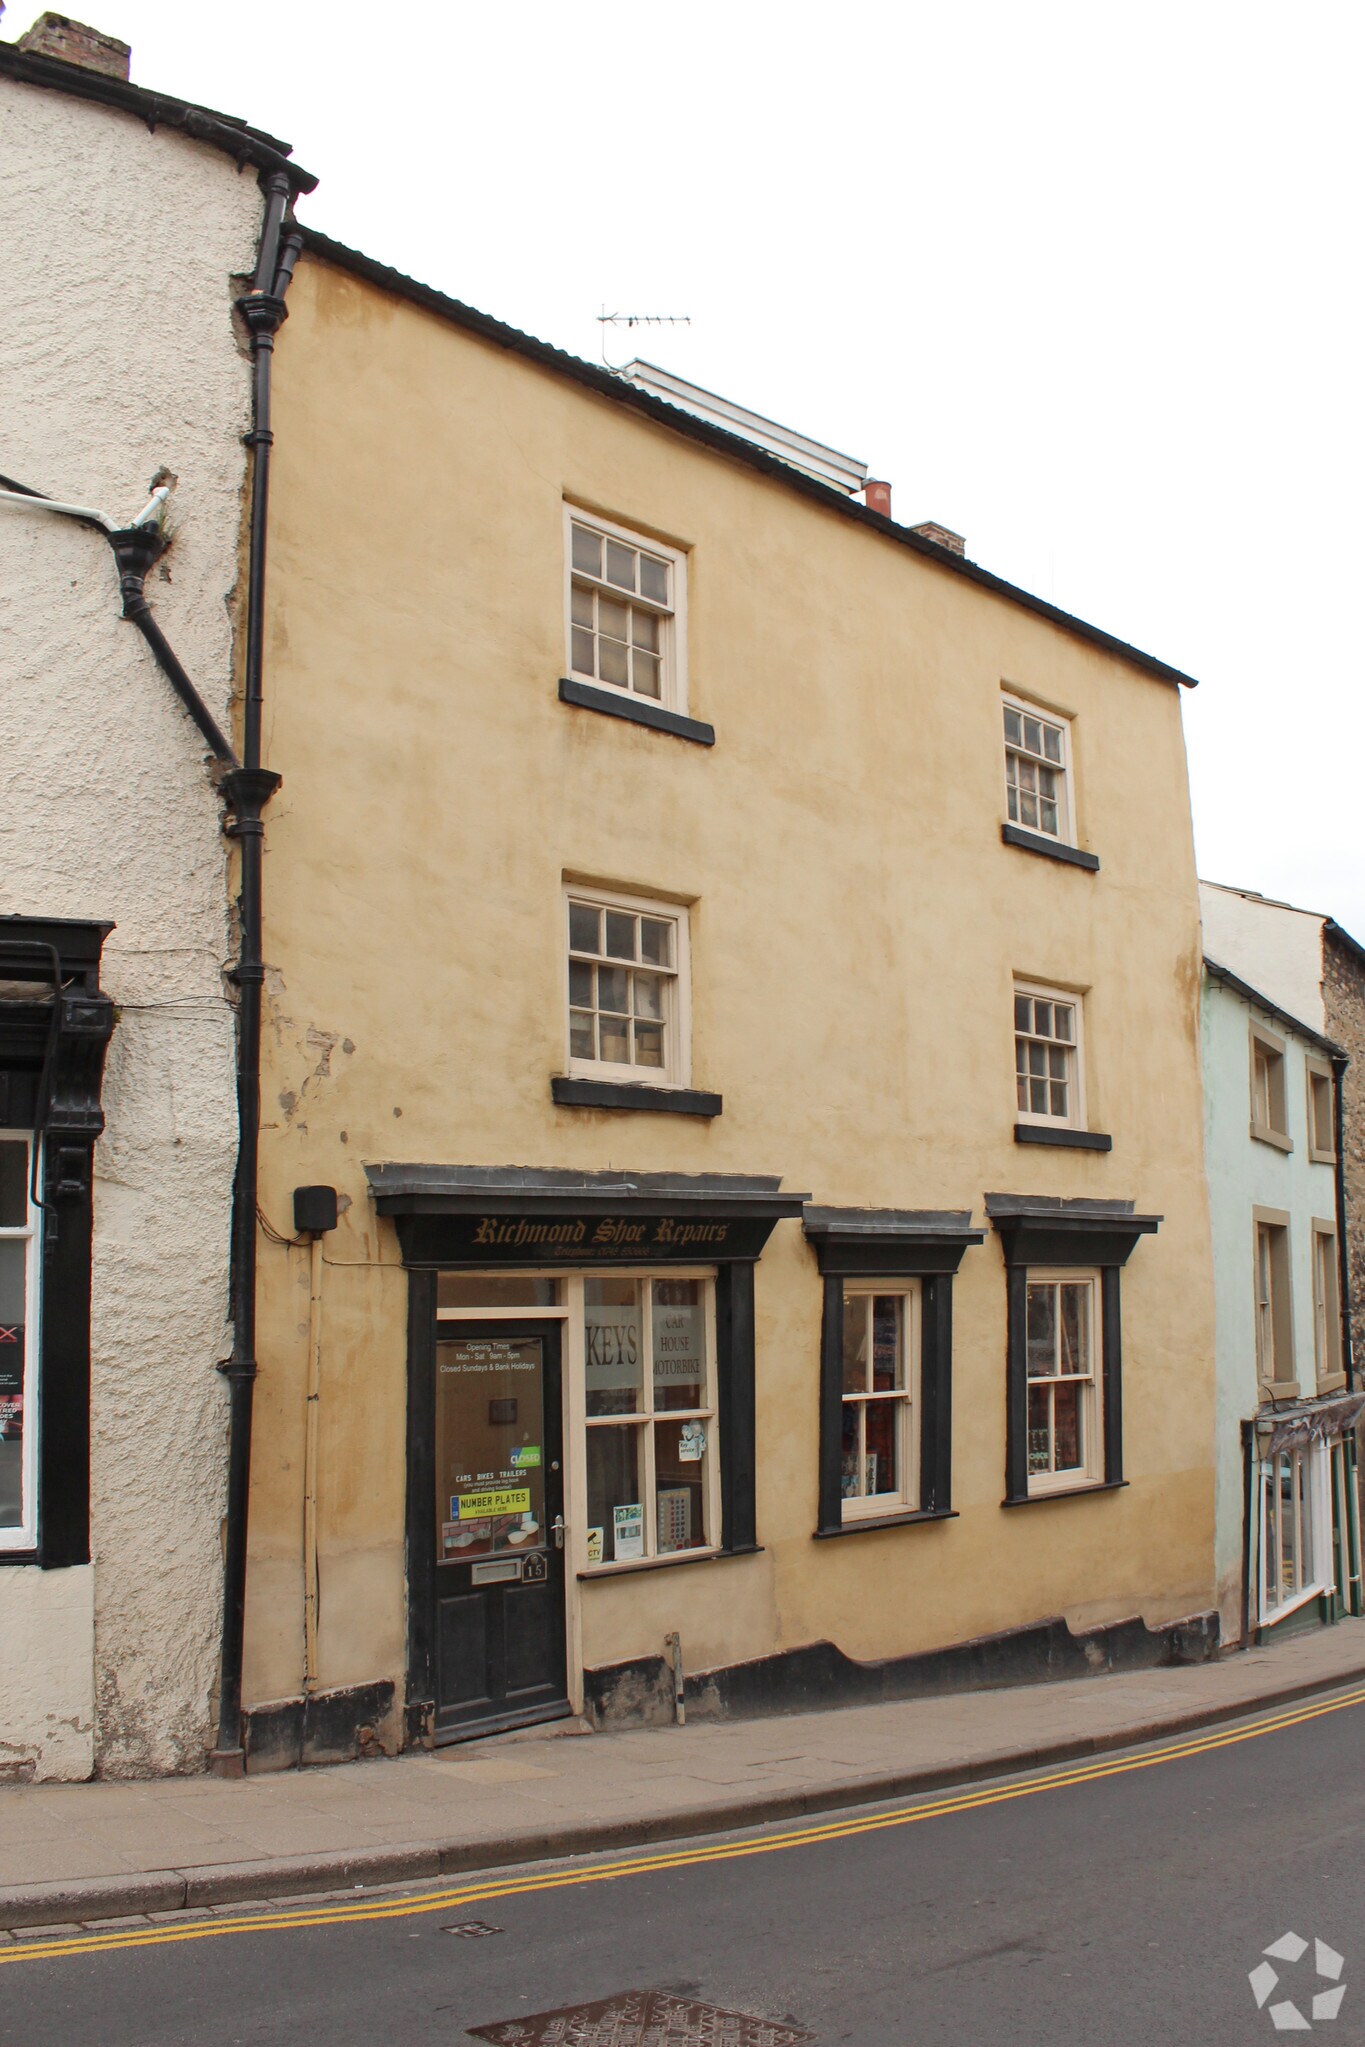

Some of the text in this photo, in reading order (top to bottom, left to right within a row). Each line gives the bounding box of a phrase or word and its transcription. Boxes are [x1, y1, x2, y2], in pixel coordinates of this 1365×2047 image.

[472, 1218, 729, 1246] Richmond Shoe Repairs
[665, 1315, 685, 1329] CAR
[466, 1342, 510, 1352] Opening Times
[585, 1325, 637, 1366] KEYS
[660, 1336, 690, 1352] HOUSE
[456, 1353, 470, 1361] Mon
[474, 1352, 485, 1360] Sat
[507, 1351, 520, 1360] 5pm
[440, 1365, 461, 1373] Closed
[462, 1364, 488, 1372] Sundays
[489, 1363, 494, 1371] &
[511, 1362, 535, 1370] Holidays
[510, 1454, 540, 1465] CLOSED
[455, 1469, 527, 1483] CARS BIKES TRAILERS
[460, 1492, 526, 1509] NUMBER PLATES
[528, 1564, 542, 1577] 15
